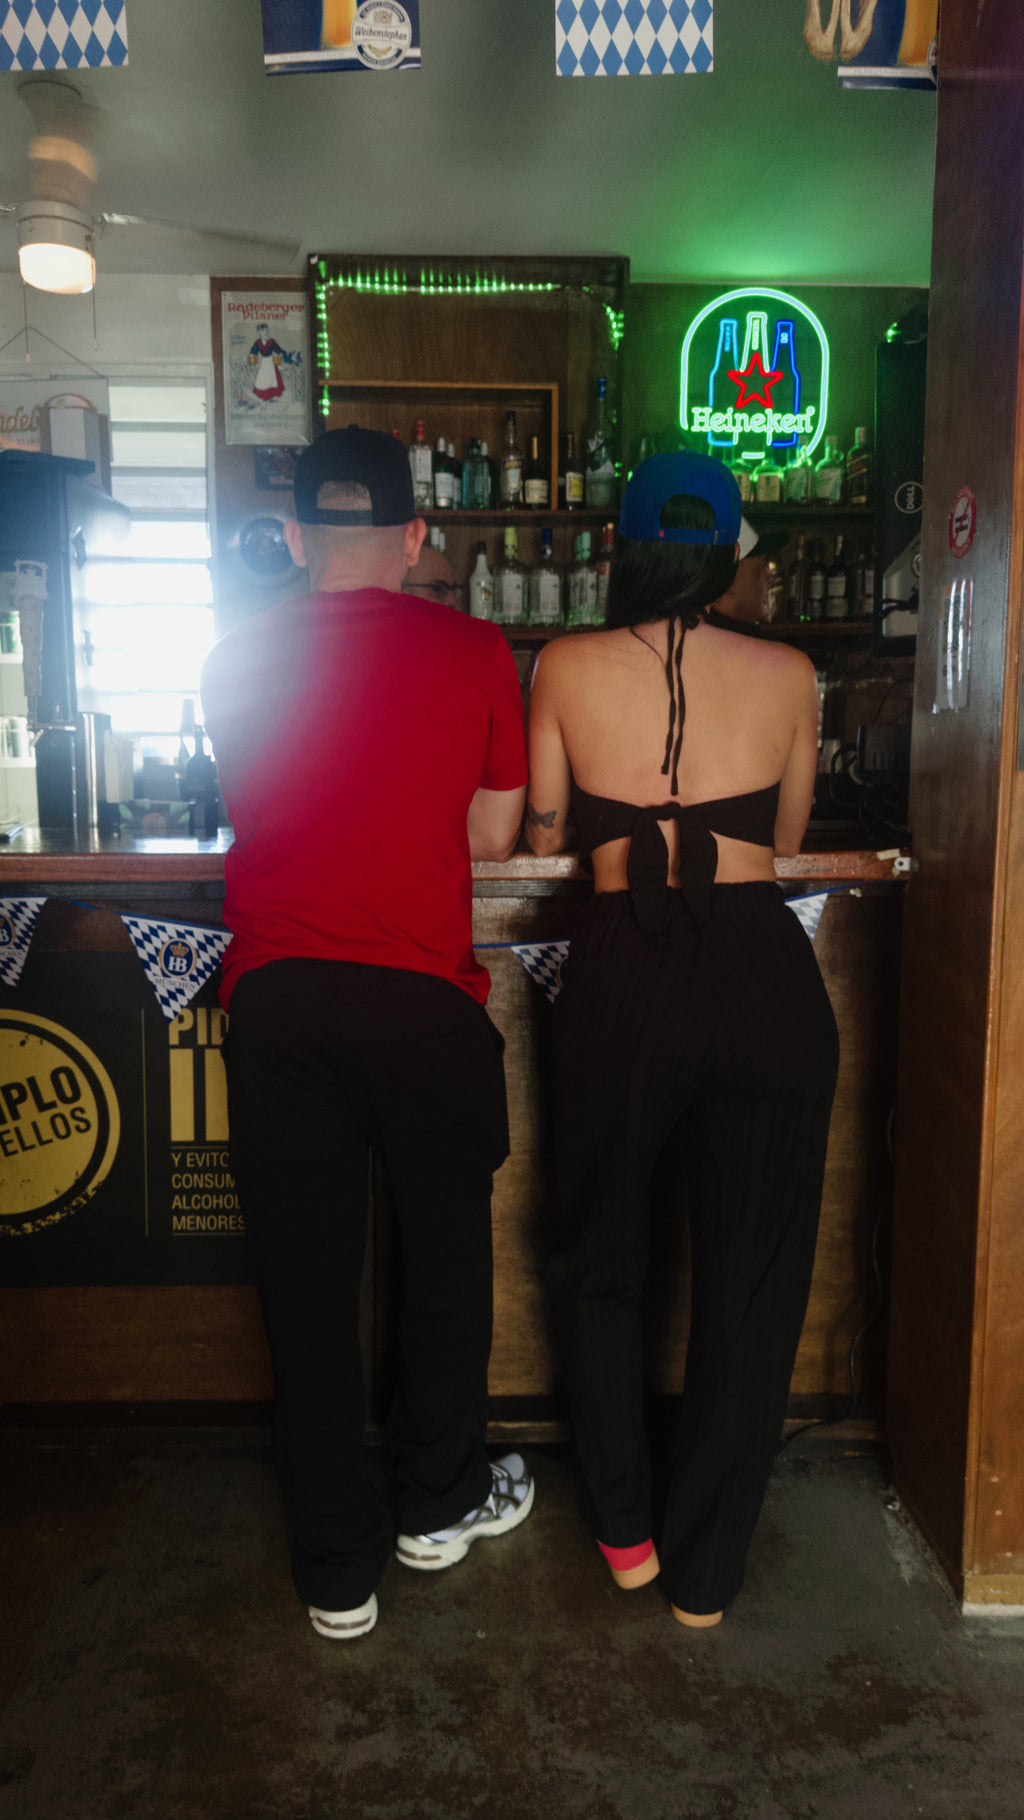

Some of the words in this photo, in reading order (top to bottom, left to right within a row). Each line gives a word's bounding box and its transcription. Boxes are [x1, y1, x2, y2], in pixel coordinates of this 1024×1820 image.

[355, 26, 408, 41] Weihenstephan
[227, 302, 305, 313] Radeberger
[243, 311, 289, 320] Pilsner
[691, 406, 815, 433] Heineken
[906, 485, 915, 510] DELL
[168, 956, 188, 973] HB
[171, 1152, 182, 1167] Y
[172, 1215, 246, 1231] MENORES
